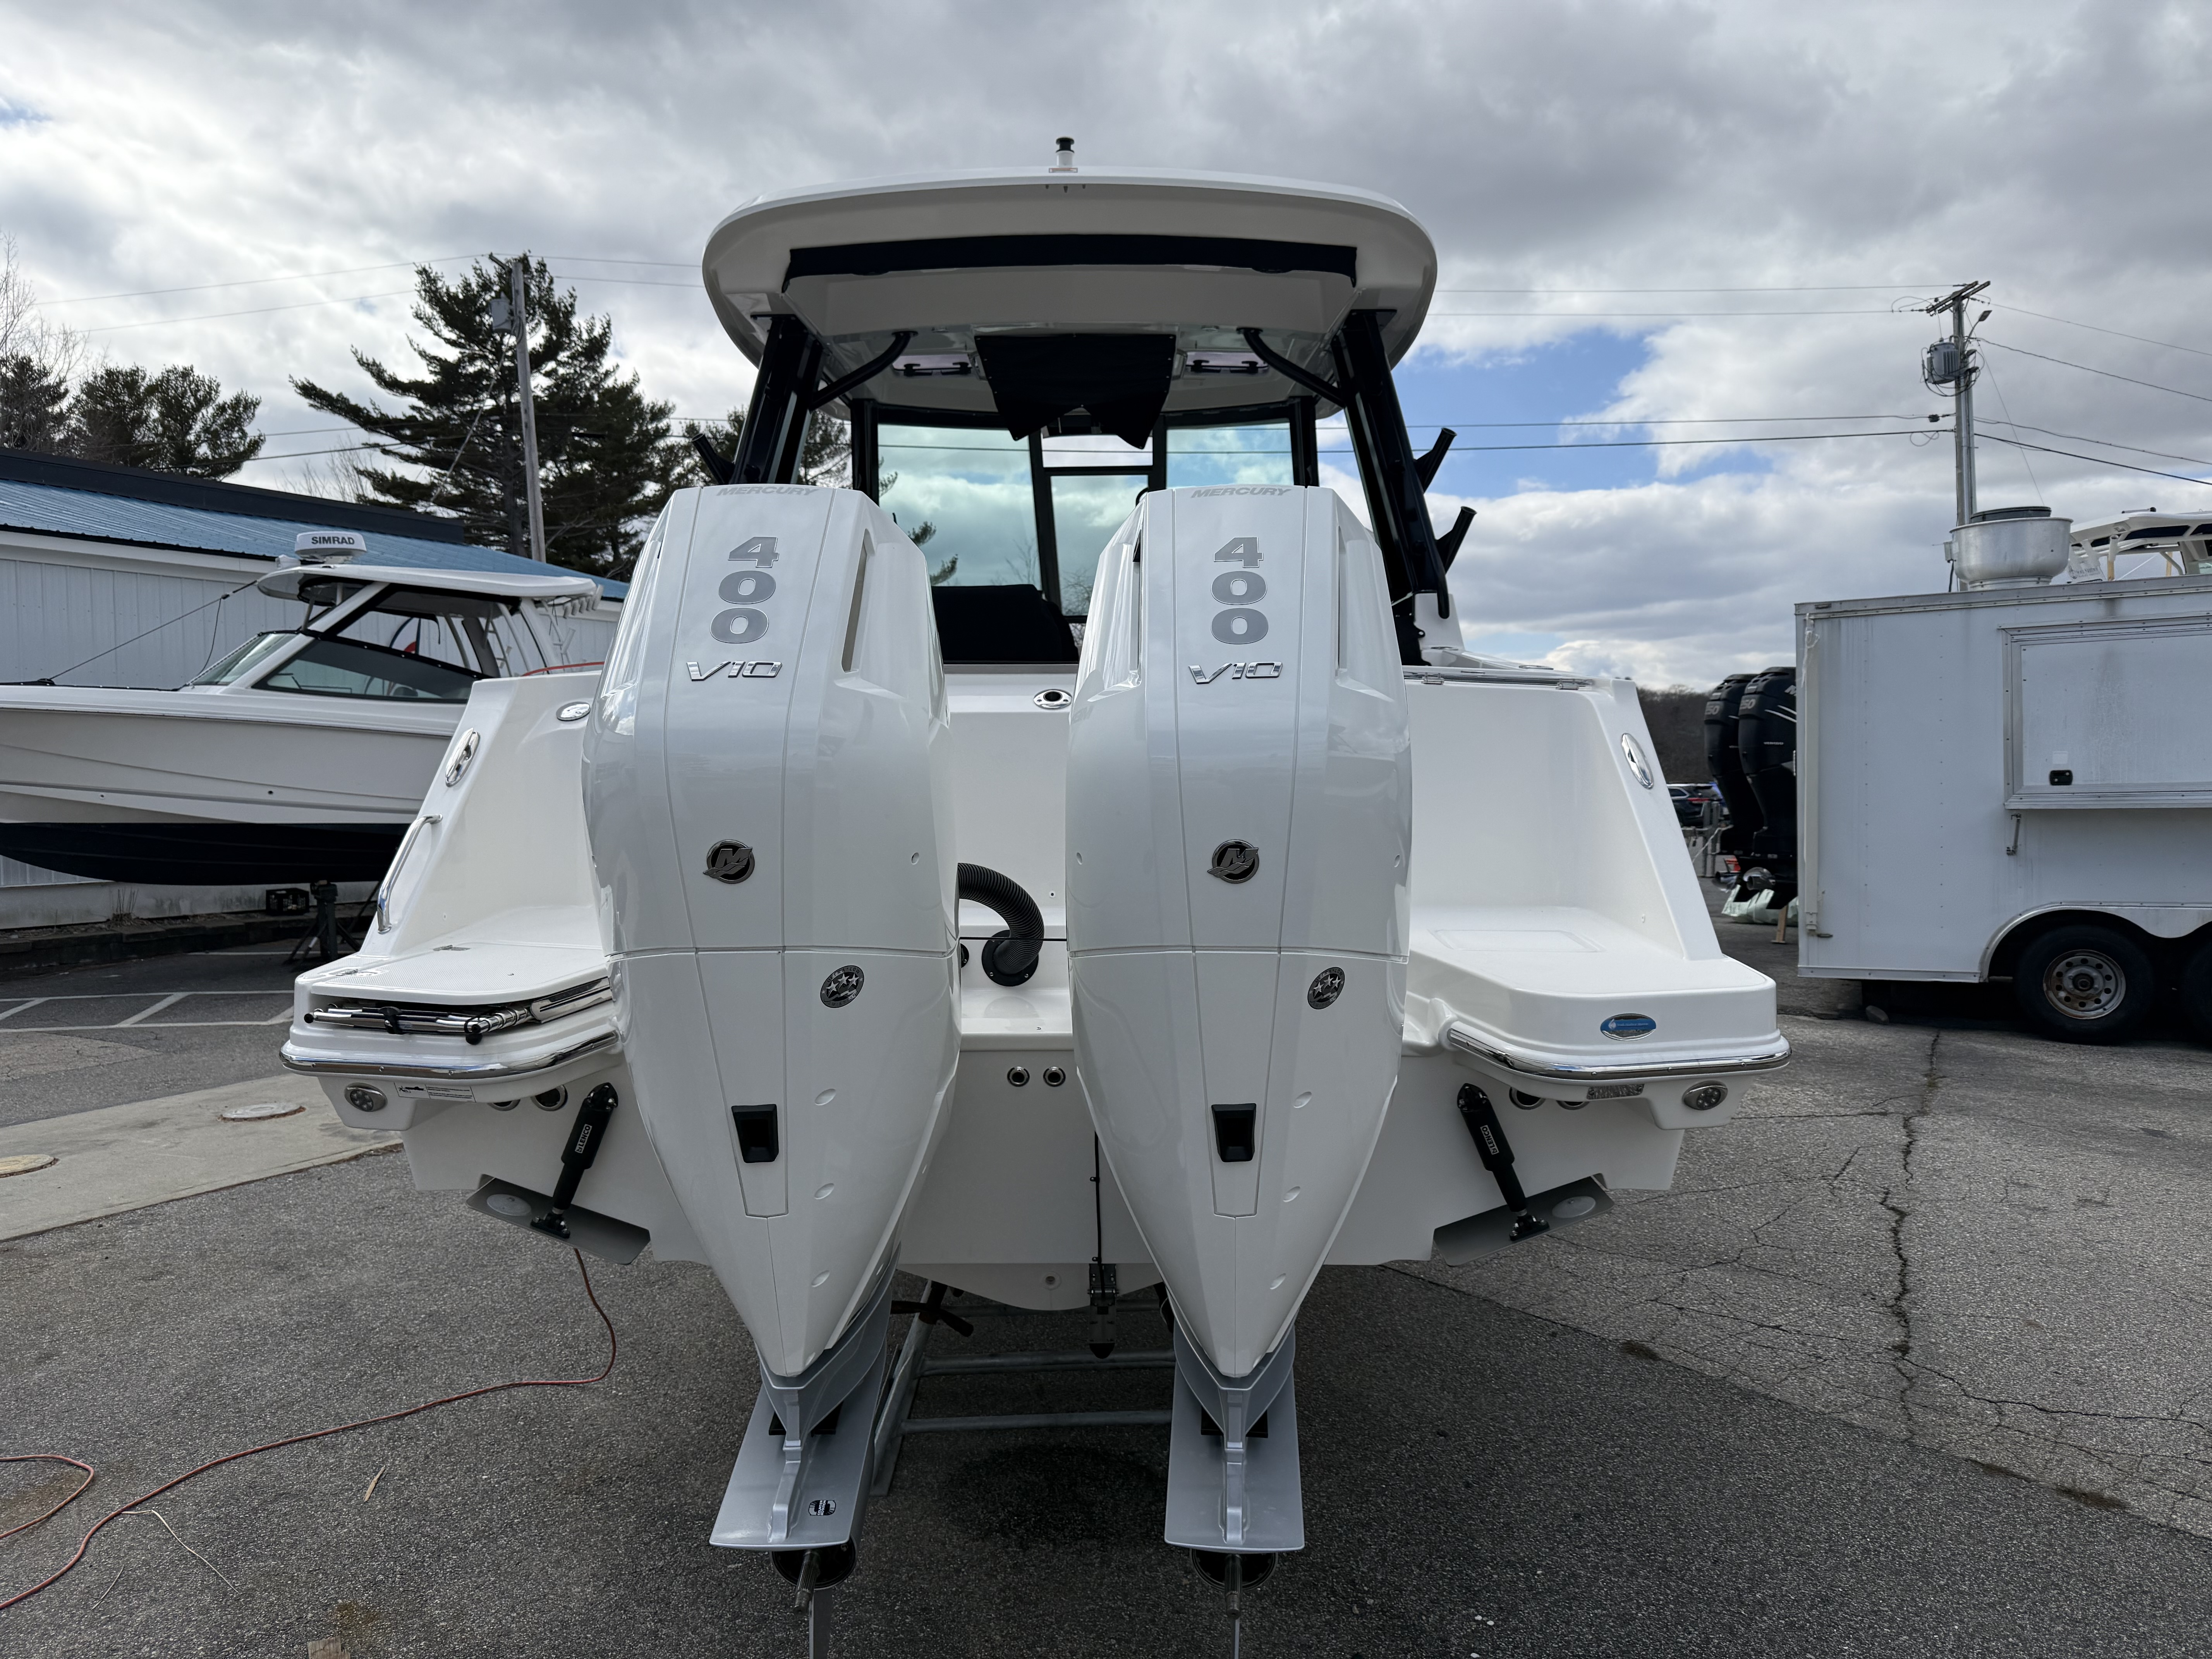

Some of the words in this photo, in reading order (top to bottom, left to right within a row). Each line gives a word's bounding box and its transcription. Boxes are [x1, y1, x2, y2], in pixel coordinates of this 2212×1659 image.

[716, 486, 819, 496] MERCURY
[1190, 487, 1291, 498] MERCURY
[311, 536, 355, 544] SIMRAD
[686, 661, 783, 682] V10
[1188, 661, 1283, 684] V10
[578, 1125, 591, 1147] LENCO
[1482, 1126, 1495, 1148] LENCO
